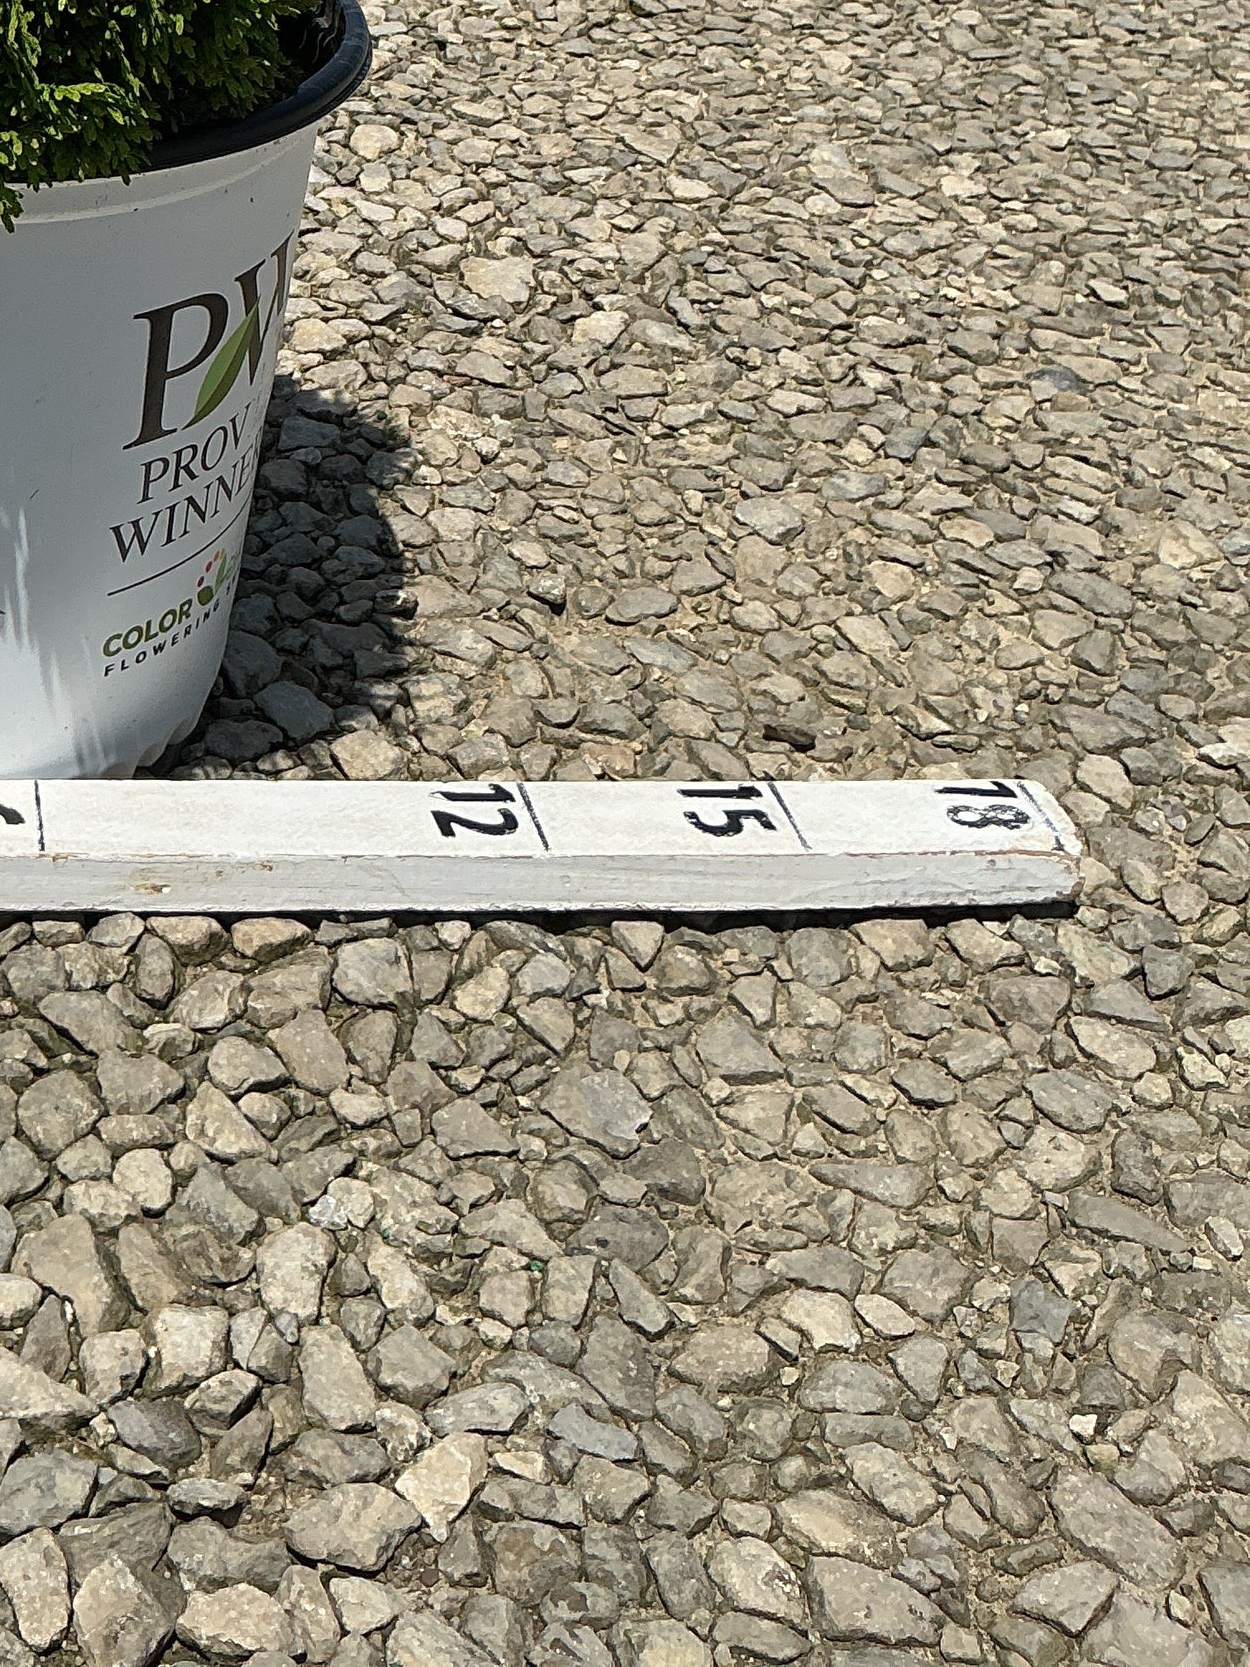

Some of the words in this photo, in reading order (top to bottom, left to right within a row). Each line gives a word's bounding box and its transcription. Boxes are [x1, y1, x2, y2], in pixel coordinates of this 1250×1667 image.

[102, 597, 194, 658] COLOR
[104, 600, 221, 678] FLOWERING
[430, 783, 519, 838] 12
[677, 781, 777, 837] 15
[935, 780, 1030, 830] 18
